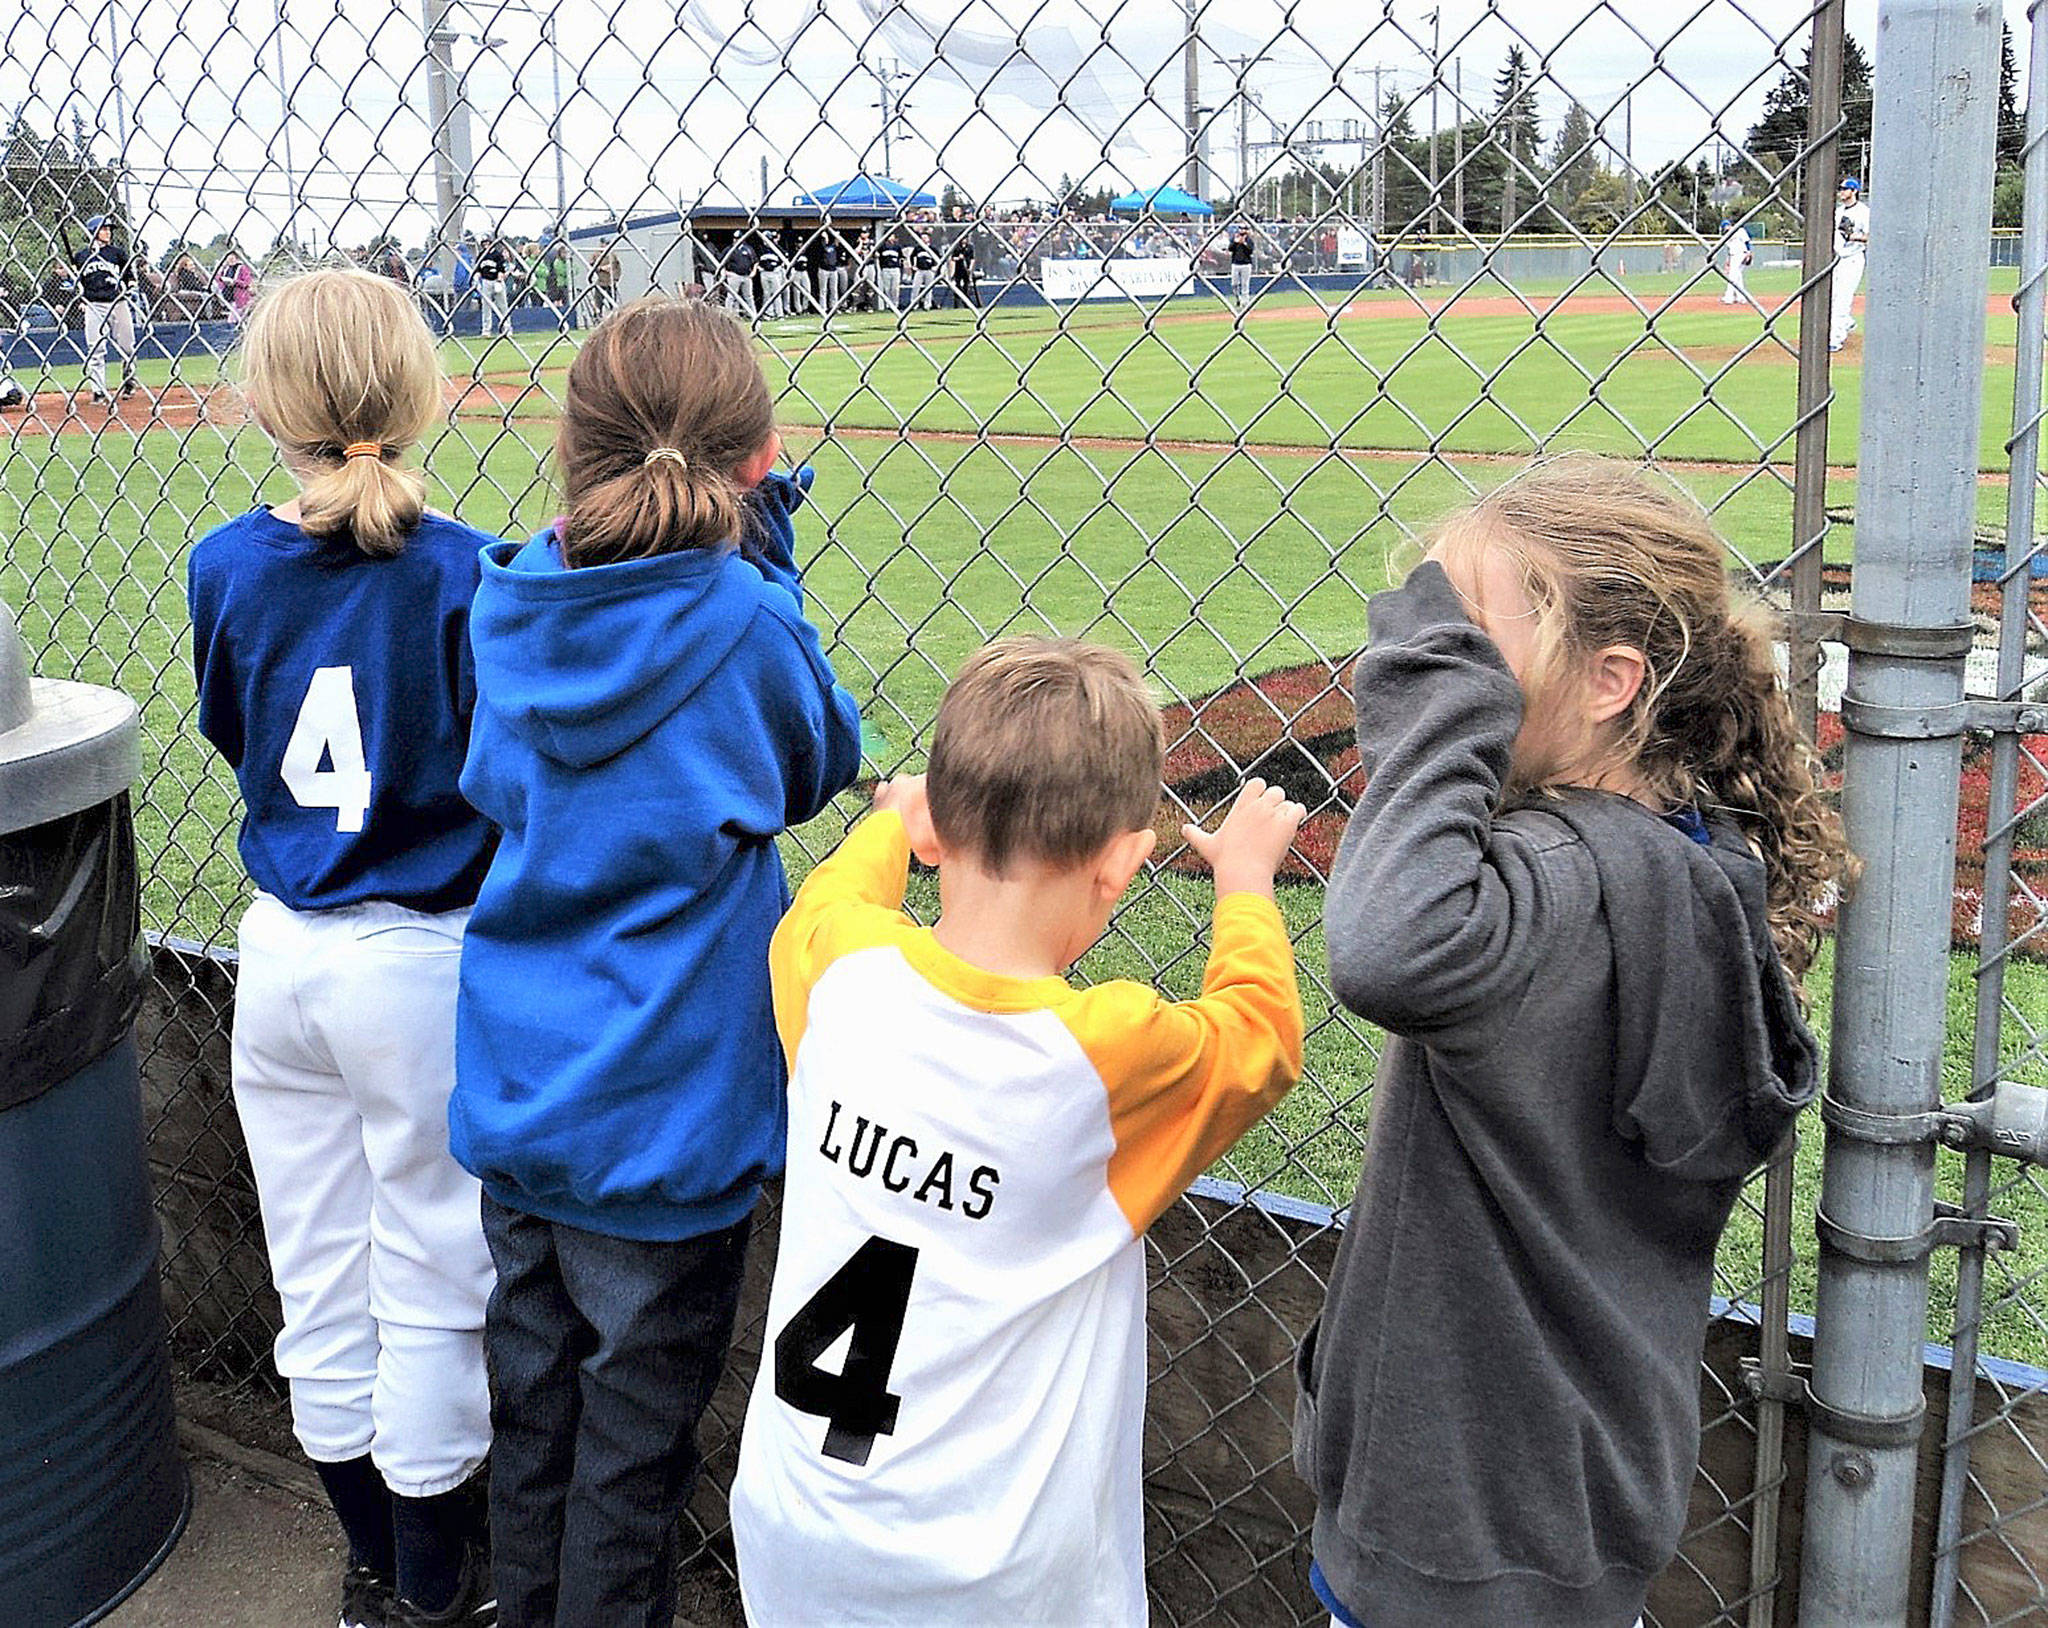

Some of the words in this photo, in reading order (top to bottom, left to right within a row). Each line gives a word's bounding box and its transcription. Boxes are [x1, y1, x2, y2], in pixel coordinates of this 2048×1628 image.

[280, 665, 372, 832] 4
[819, 1100, 1001, 1220] LUCAS
[774, 1235, 920, 1466] 4
